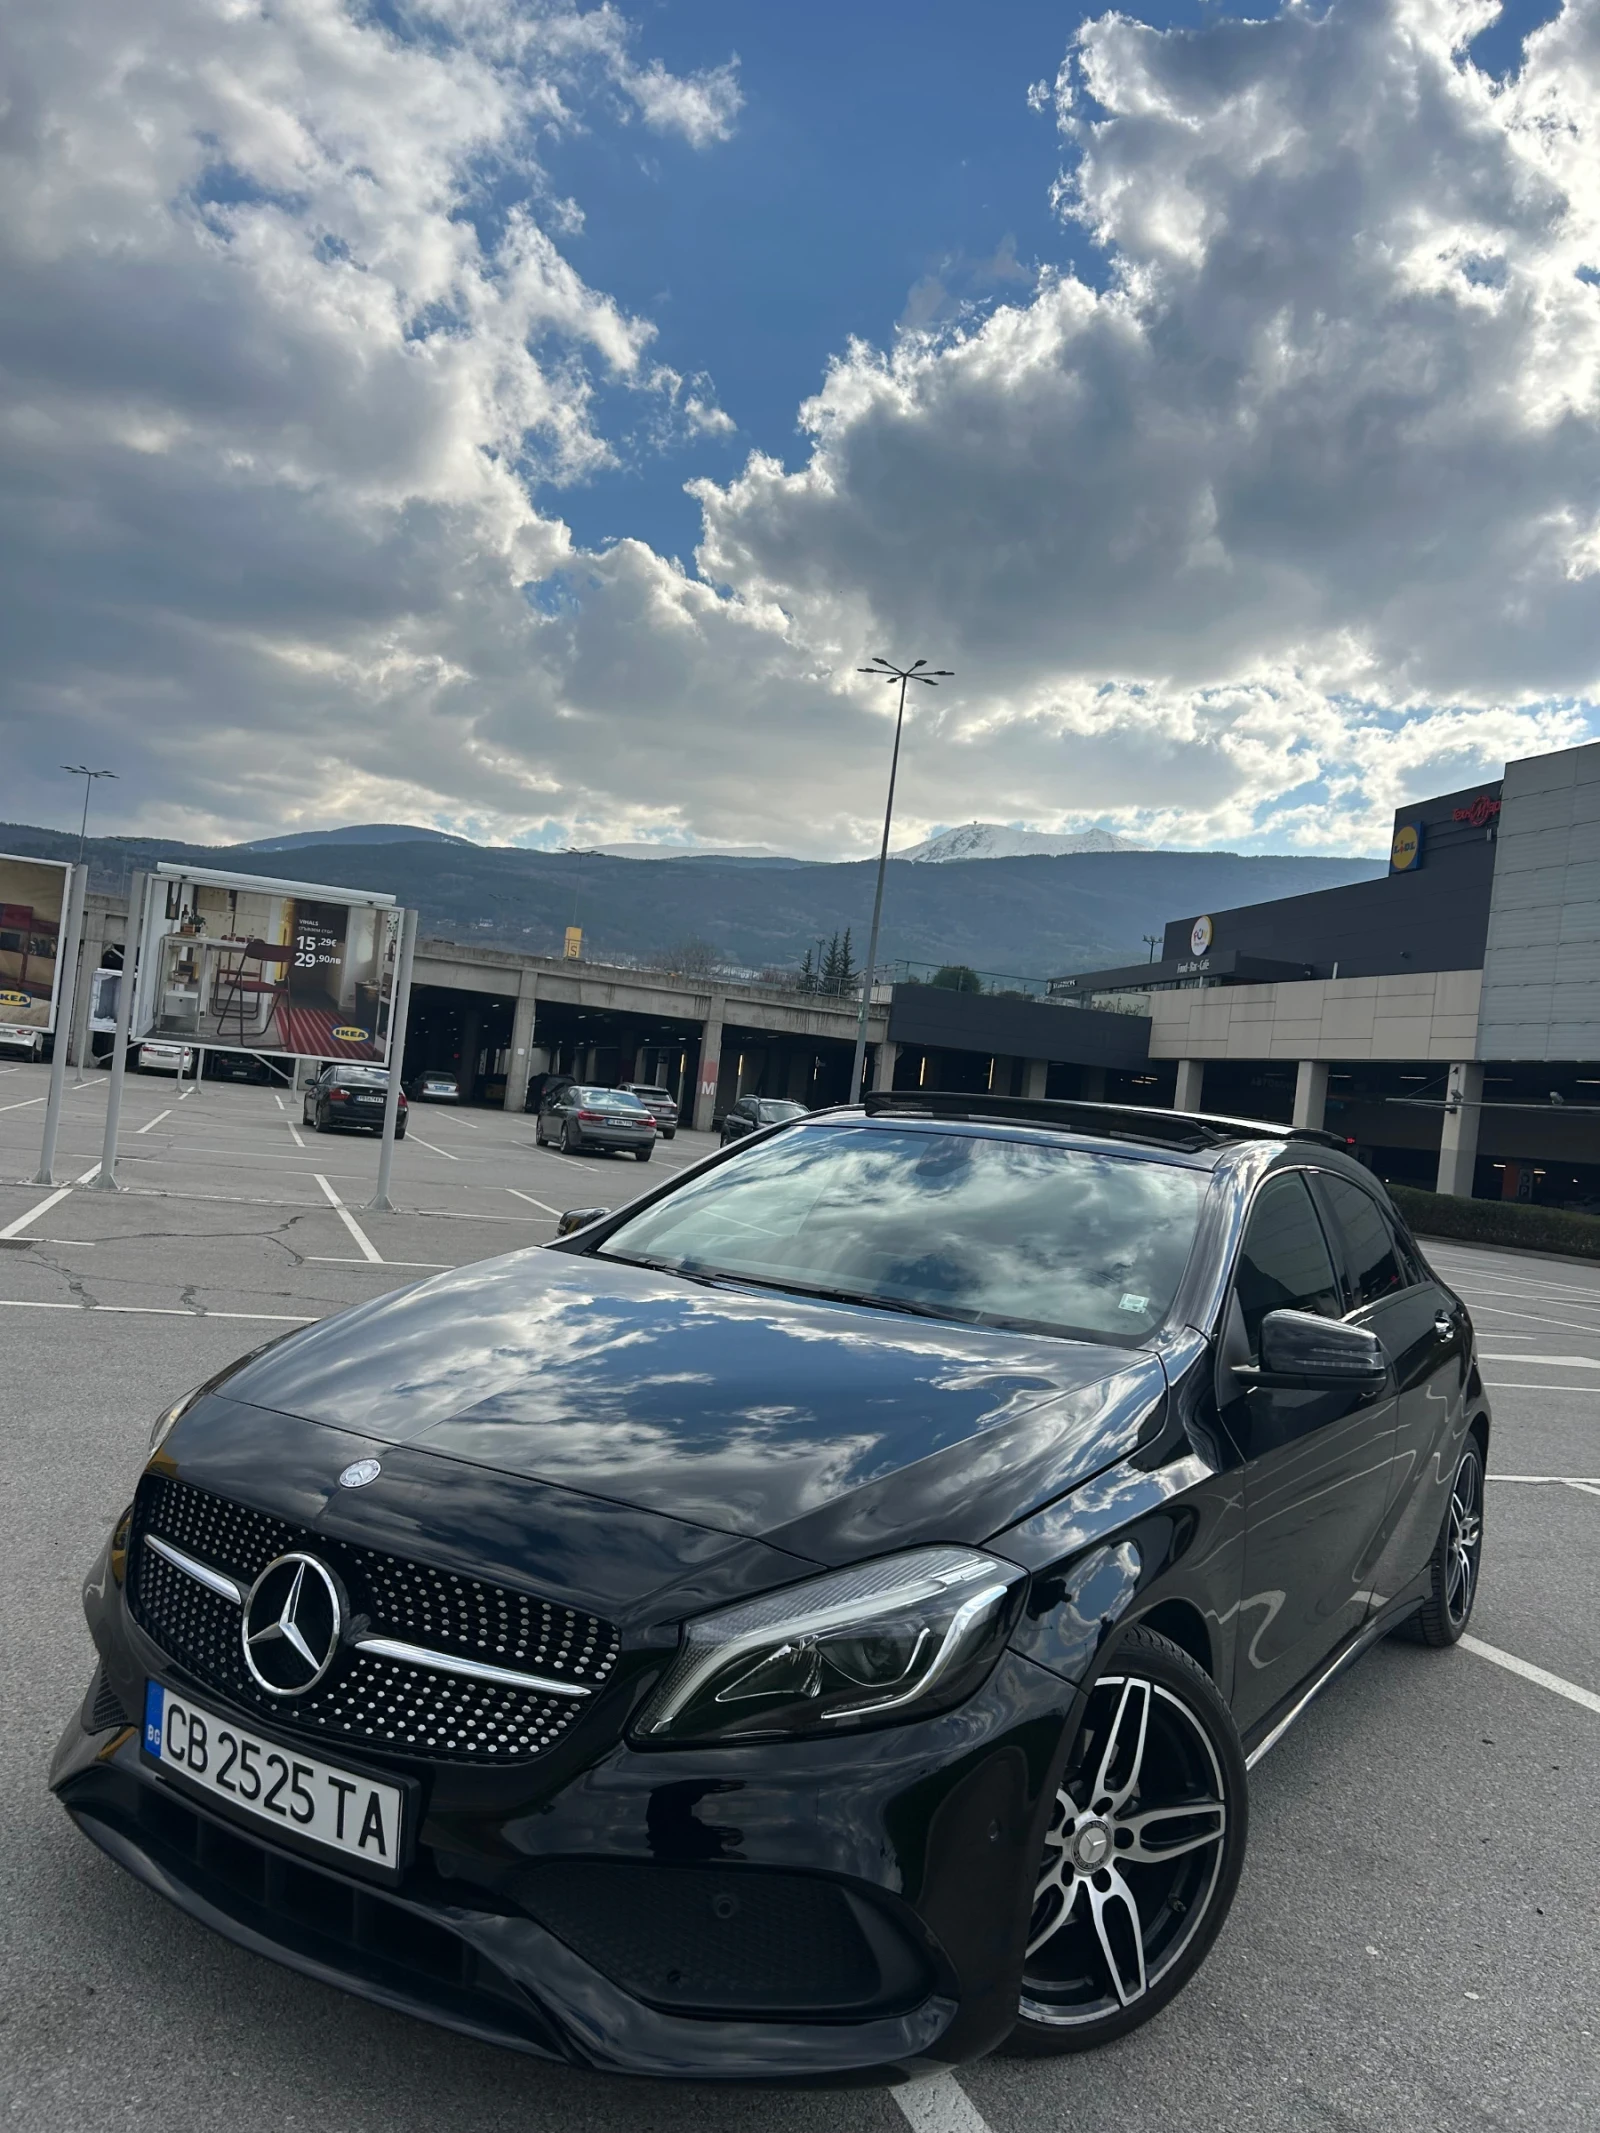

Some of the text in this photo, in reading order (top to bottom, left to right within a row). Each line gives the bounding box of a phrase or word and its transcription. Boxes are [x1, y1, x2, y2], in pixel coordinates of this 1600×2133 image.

[335, 1029, 366, 1038] IKEA
[701, 1081, 715, 1096] M
[146, 1723, 161, 1746] BG
[166, 1703, 387, 1857] CB 2525 TA
